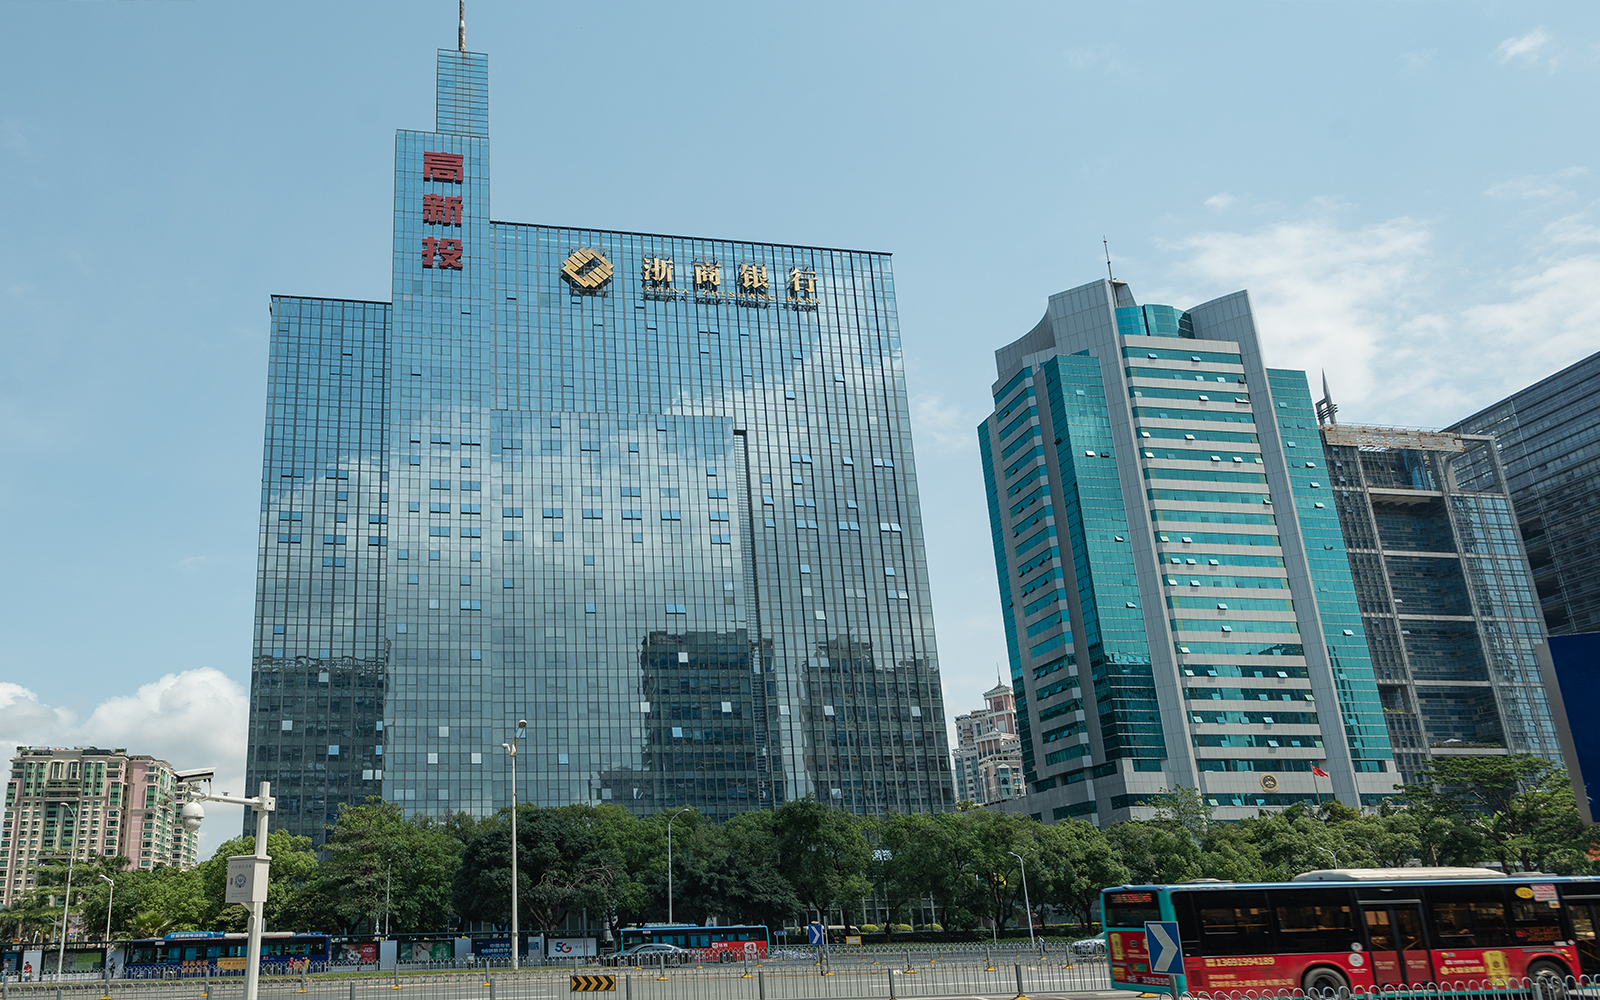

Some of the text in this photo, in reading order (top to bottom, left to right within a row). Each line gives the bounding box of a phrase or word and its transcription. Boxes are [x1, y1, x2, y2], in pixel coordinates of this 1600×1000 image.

[422, 151, 464, 270] 高新投
[643, 257, 818, 293] 浙商银行
[646, 285, 821, 305] CHINA ZHESHANG BANK
[554, 941, 572, 954] 5G
